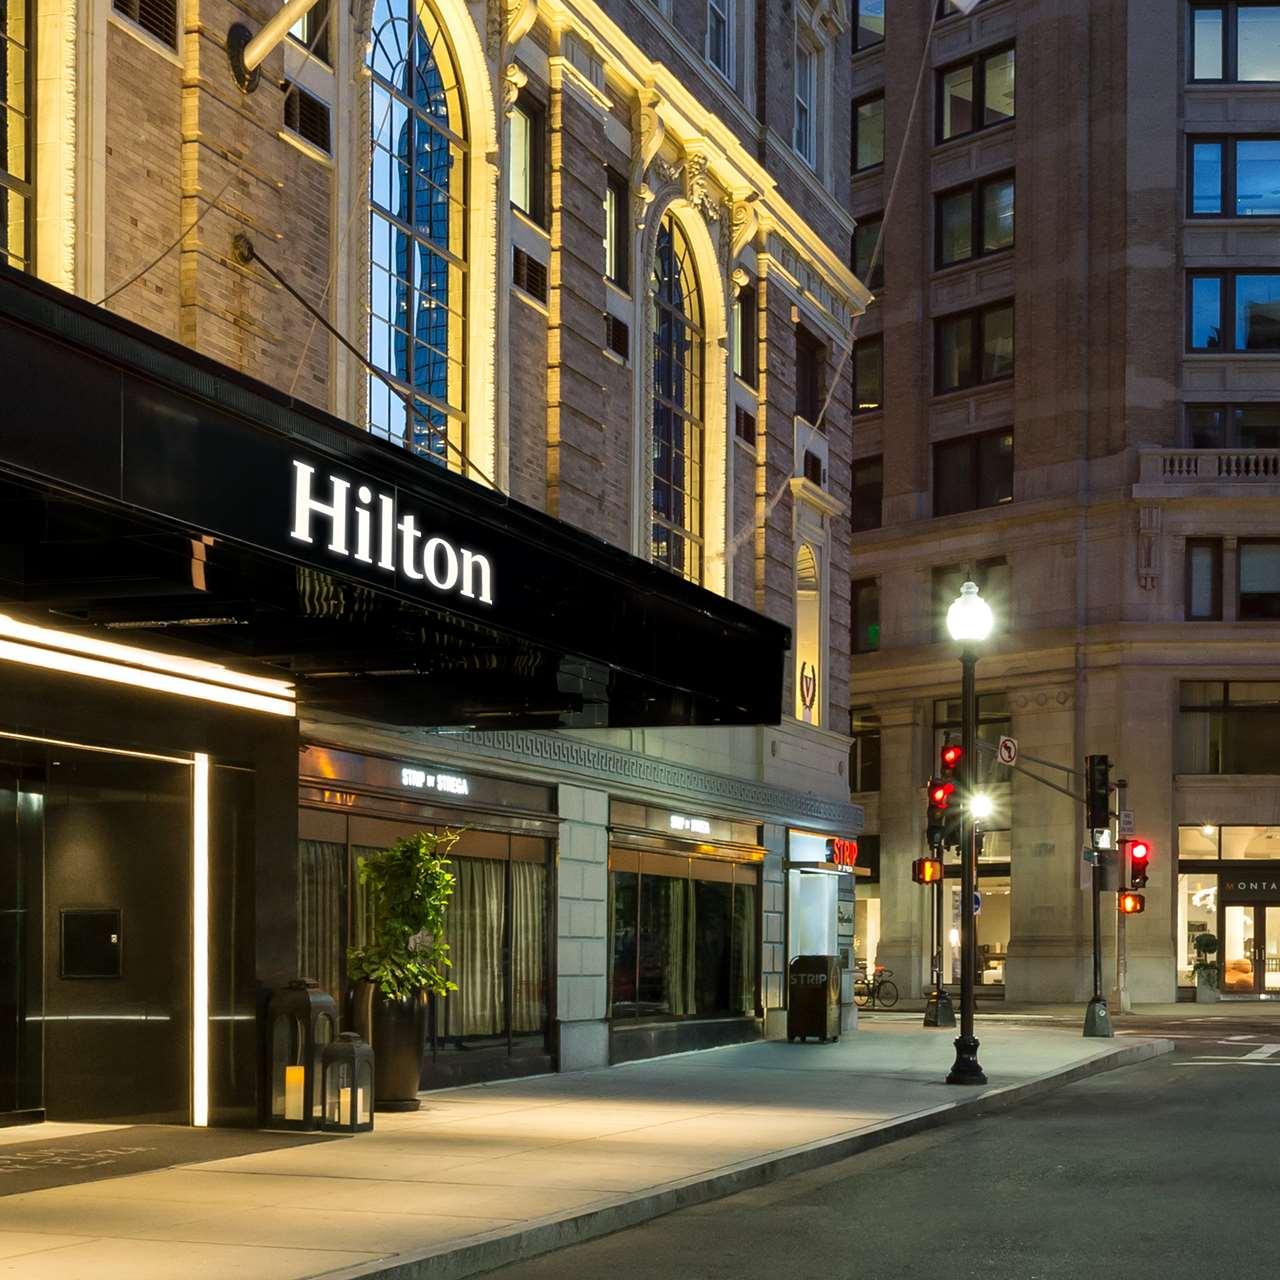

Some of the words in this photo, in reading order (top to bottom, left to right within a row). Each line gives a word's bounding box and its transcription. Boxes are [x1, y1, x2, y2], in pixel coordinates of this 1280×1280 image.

[290, 459, 493, 607] Hilton
[833, 838, 858, 866] STRIP
[790, 973, 827, 985] STRIP
